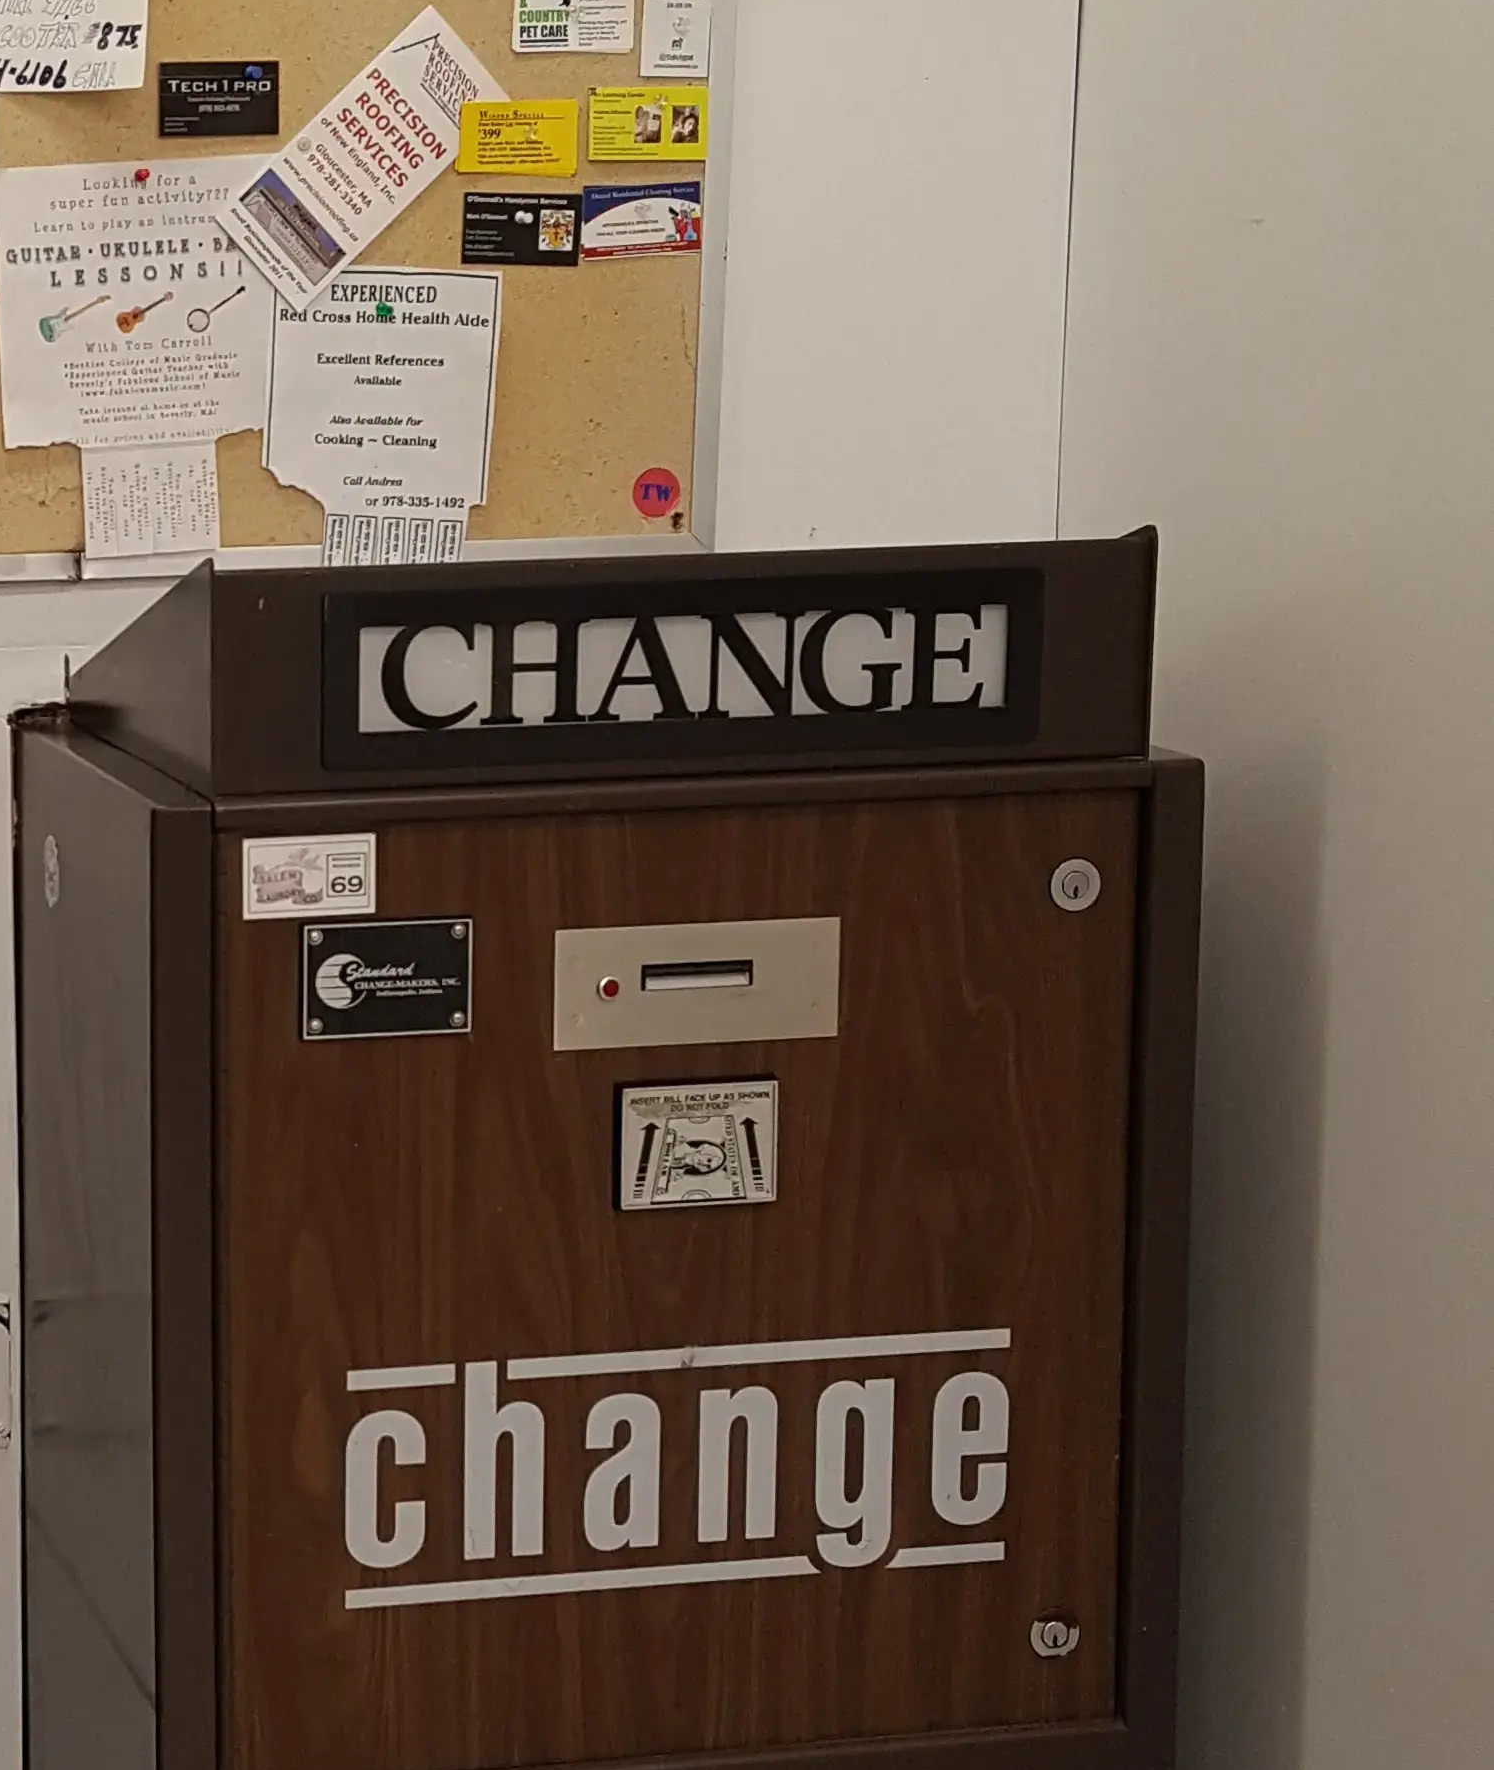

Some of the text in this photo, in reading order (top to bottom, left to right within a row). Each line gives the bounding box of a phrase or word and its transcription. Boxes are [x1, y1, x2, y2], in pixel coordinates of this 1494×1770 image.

[519, 10, 569, 23] COUNTRY
[520, 25, 568, 38] PET CARE
[222, 80, 228, 91] 1
[234, 80, 271, 91] PRO
[365, 67, 448, 160] PRECISION
[354, 90, 425, 170] ROOFING
[335, 107, 409, 188] SERVICES
[319, 117, 396, 205] of New England, Inc.
[82, 173, 197, 191] Looking for a
[306, 153, 363, 216] 978-281-3340
[315, 142, 372, 209] Gloucester, MA
[49, 186, 229, 211] super fun activity???
[5, 244, 81, 265] GUITAR
[99, 237, 190, 259] UKULELE
[330, 283, 438, 305] EXPERIENCED
[279, 306, 490, 328] Red Cross Home Health Aide
[84, 334, 212, 354] With Tom Carroll
[316, 352, 445, 367] Excellent References
[353, 375, 402, 386] Available
[328, 414, 424, 426] Also Available for
[314, 432, 438, 450] Cooking Cleaning
[342, 475, 403, 487] Call Andrea
[639, 483, 674, 502] TW
[364, 495, 465, 509] or 978-335-1492
[380, 602, 986, 730] CHANGE
[331, 876, 363, 893] 69
[346, 962, 416, 980] Standard
[441, 978, 461, 986] INC.
[630, 1097, 660, 1105] INSERT
[738, 1091, 770, 1099] SHOWN
[706, 1102, 729, 1110] FOLD
[344, 1360, 1011, 1570] change
